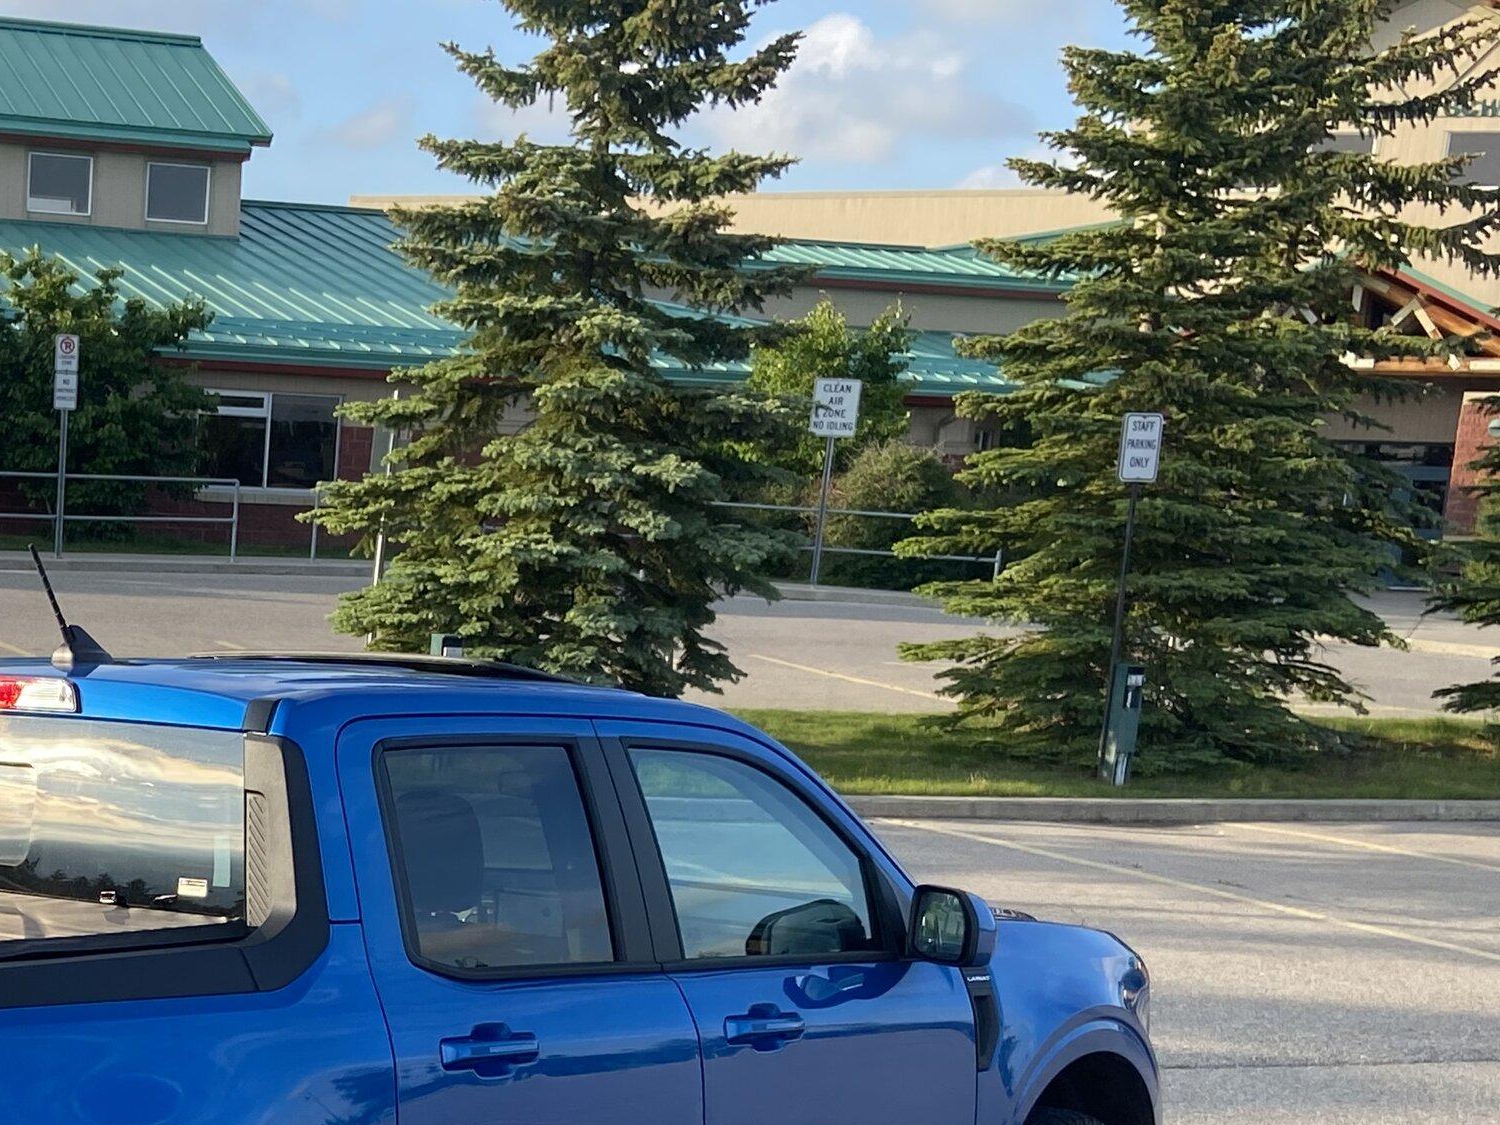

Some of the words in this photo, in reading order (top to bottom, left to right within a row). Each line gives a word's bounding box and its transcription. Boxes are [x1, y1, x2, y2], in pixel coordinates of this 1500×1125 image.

[823, 384, 852, 394] CLEAN
[828, 396, 844, 406] AIR
[822, 409, 846, 419] ZONE
[813, 420, 824, 430] NO
[826, 421, 854, 431] IDLING
[1132, 420, 1156, 432] STAFF
[1126, 439, 1157, 450] PARKING
[1129, 456, 1150, 468] ONLY
